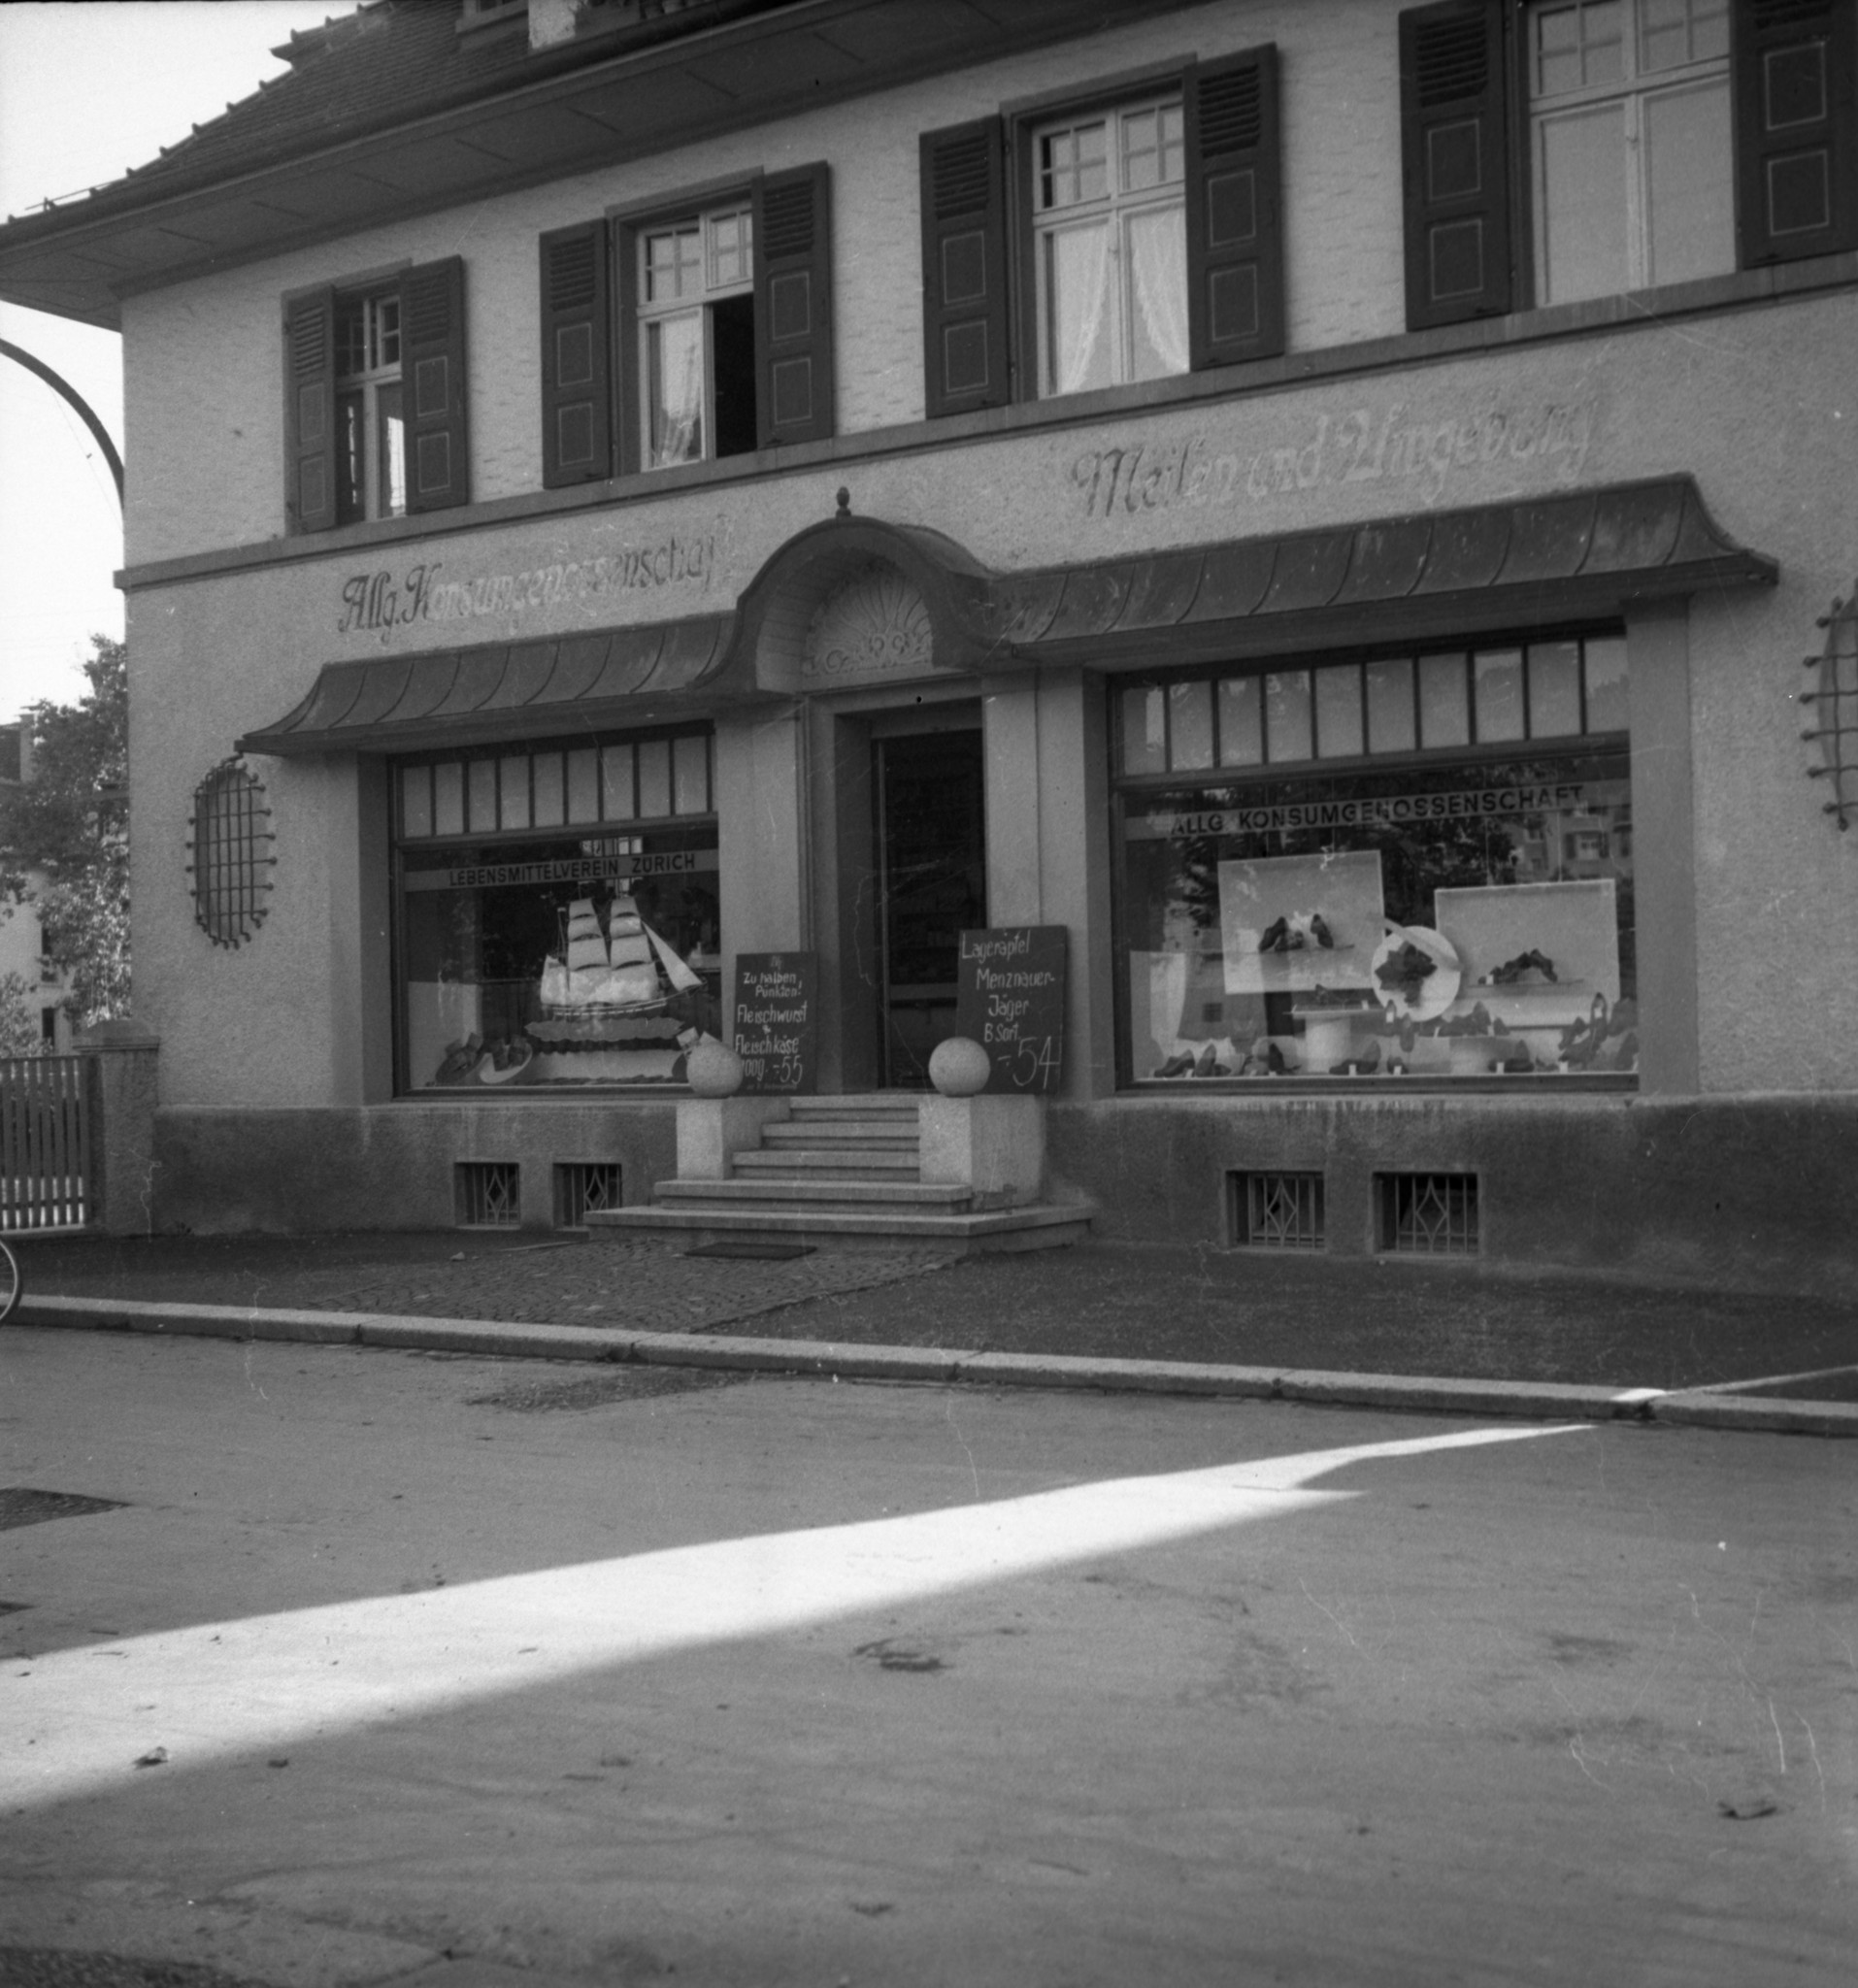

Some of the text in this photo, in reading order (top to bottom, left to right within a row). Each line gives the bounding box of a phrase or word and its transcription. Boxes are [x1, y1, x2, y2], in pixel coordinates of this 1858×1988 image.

[337, 569, 401, 645] Allg.
[1238, 784, 1584, 830] KONSUMGENOSSENSCHAFT
[448, 859, 619, 887] LEBENSMITTELVEREIN
[743, 971, 797, 984] Zu halben
[737, 1000, 809, 1024] Fleischwurst
[988, 993, 1030, 1022] Jäger
[735, 1034, 800, 1055] Fleischkäse
[984, 1022, 994, 1043] B
